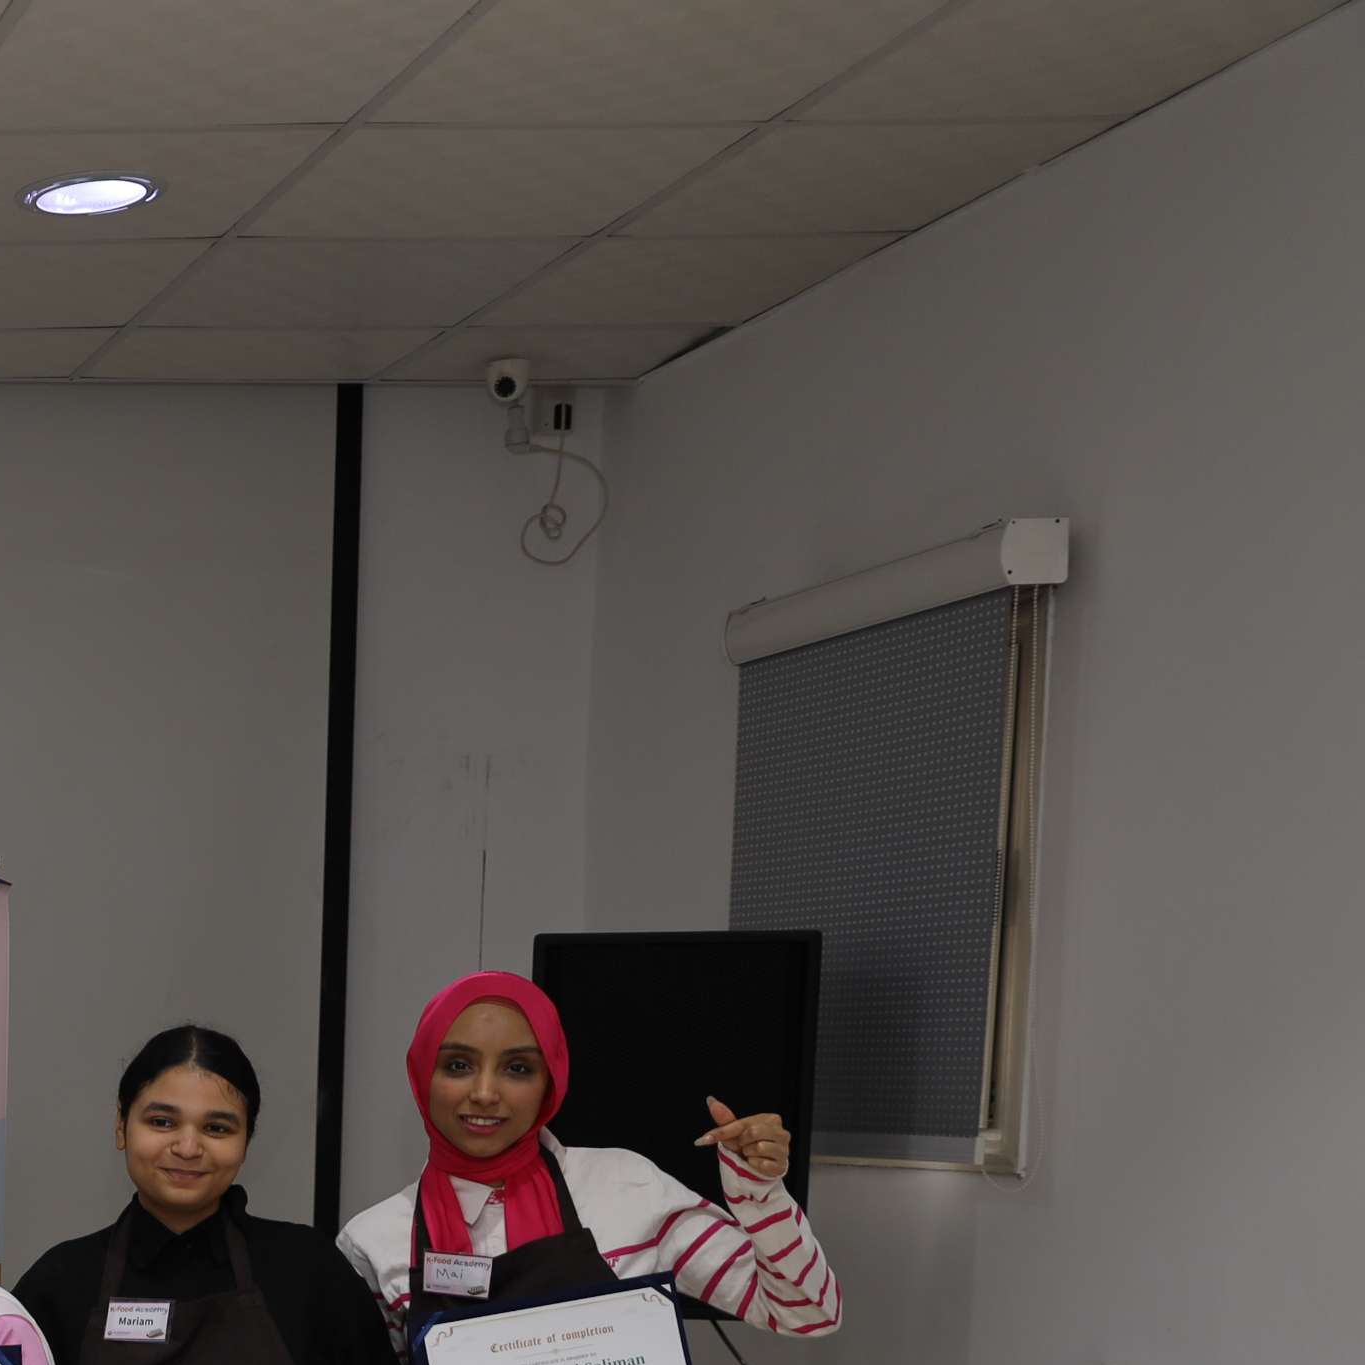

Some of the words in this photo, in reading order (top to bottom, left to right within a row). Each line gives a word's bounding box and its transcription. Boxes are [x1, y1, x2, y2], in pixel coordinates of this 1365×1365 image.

[436, 1268, 463, 1280] Mai
[118, 1316, 154, 1326] Mariam
[489, 1337, 541, 1353] Certificate
[546, 1332, 557, 1343] of
[561, 1325, 613, 1341] completion
